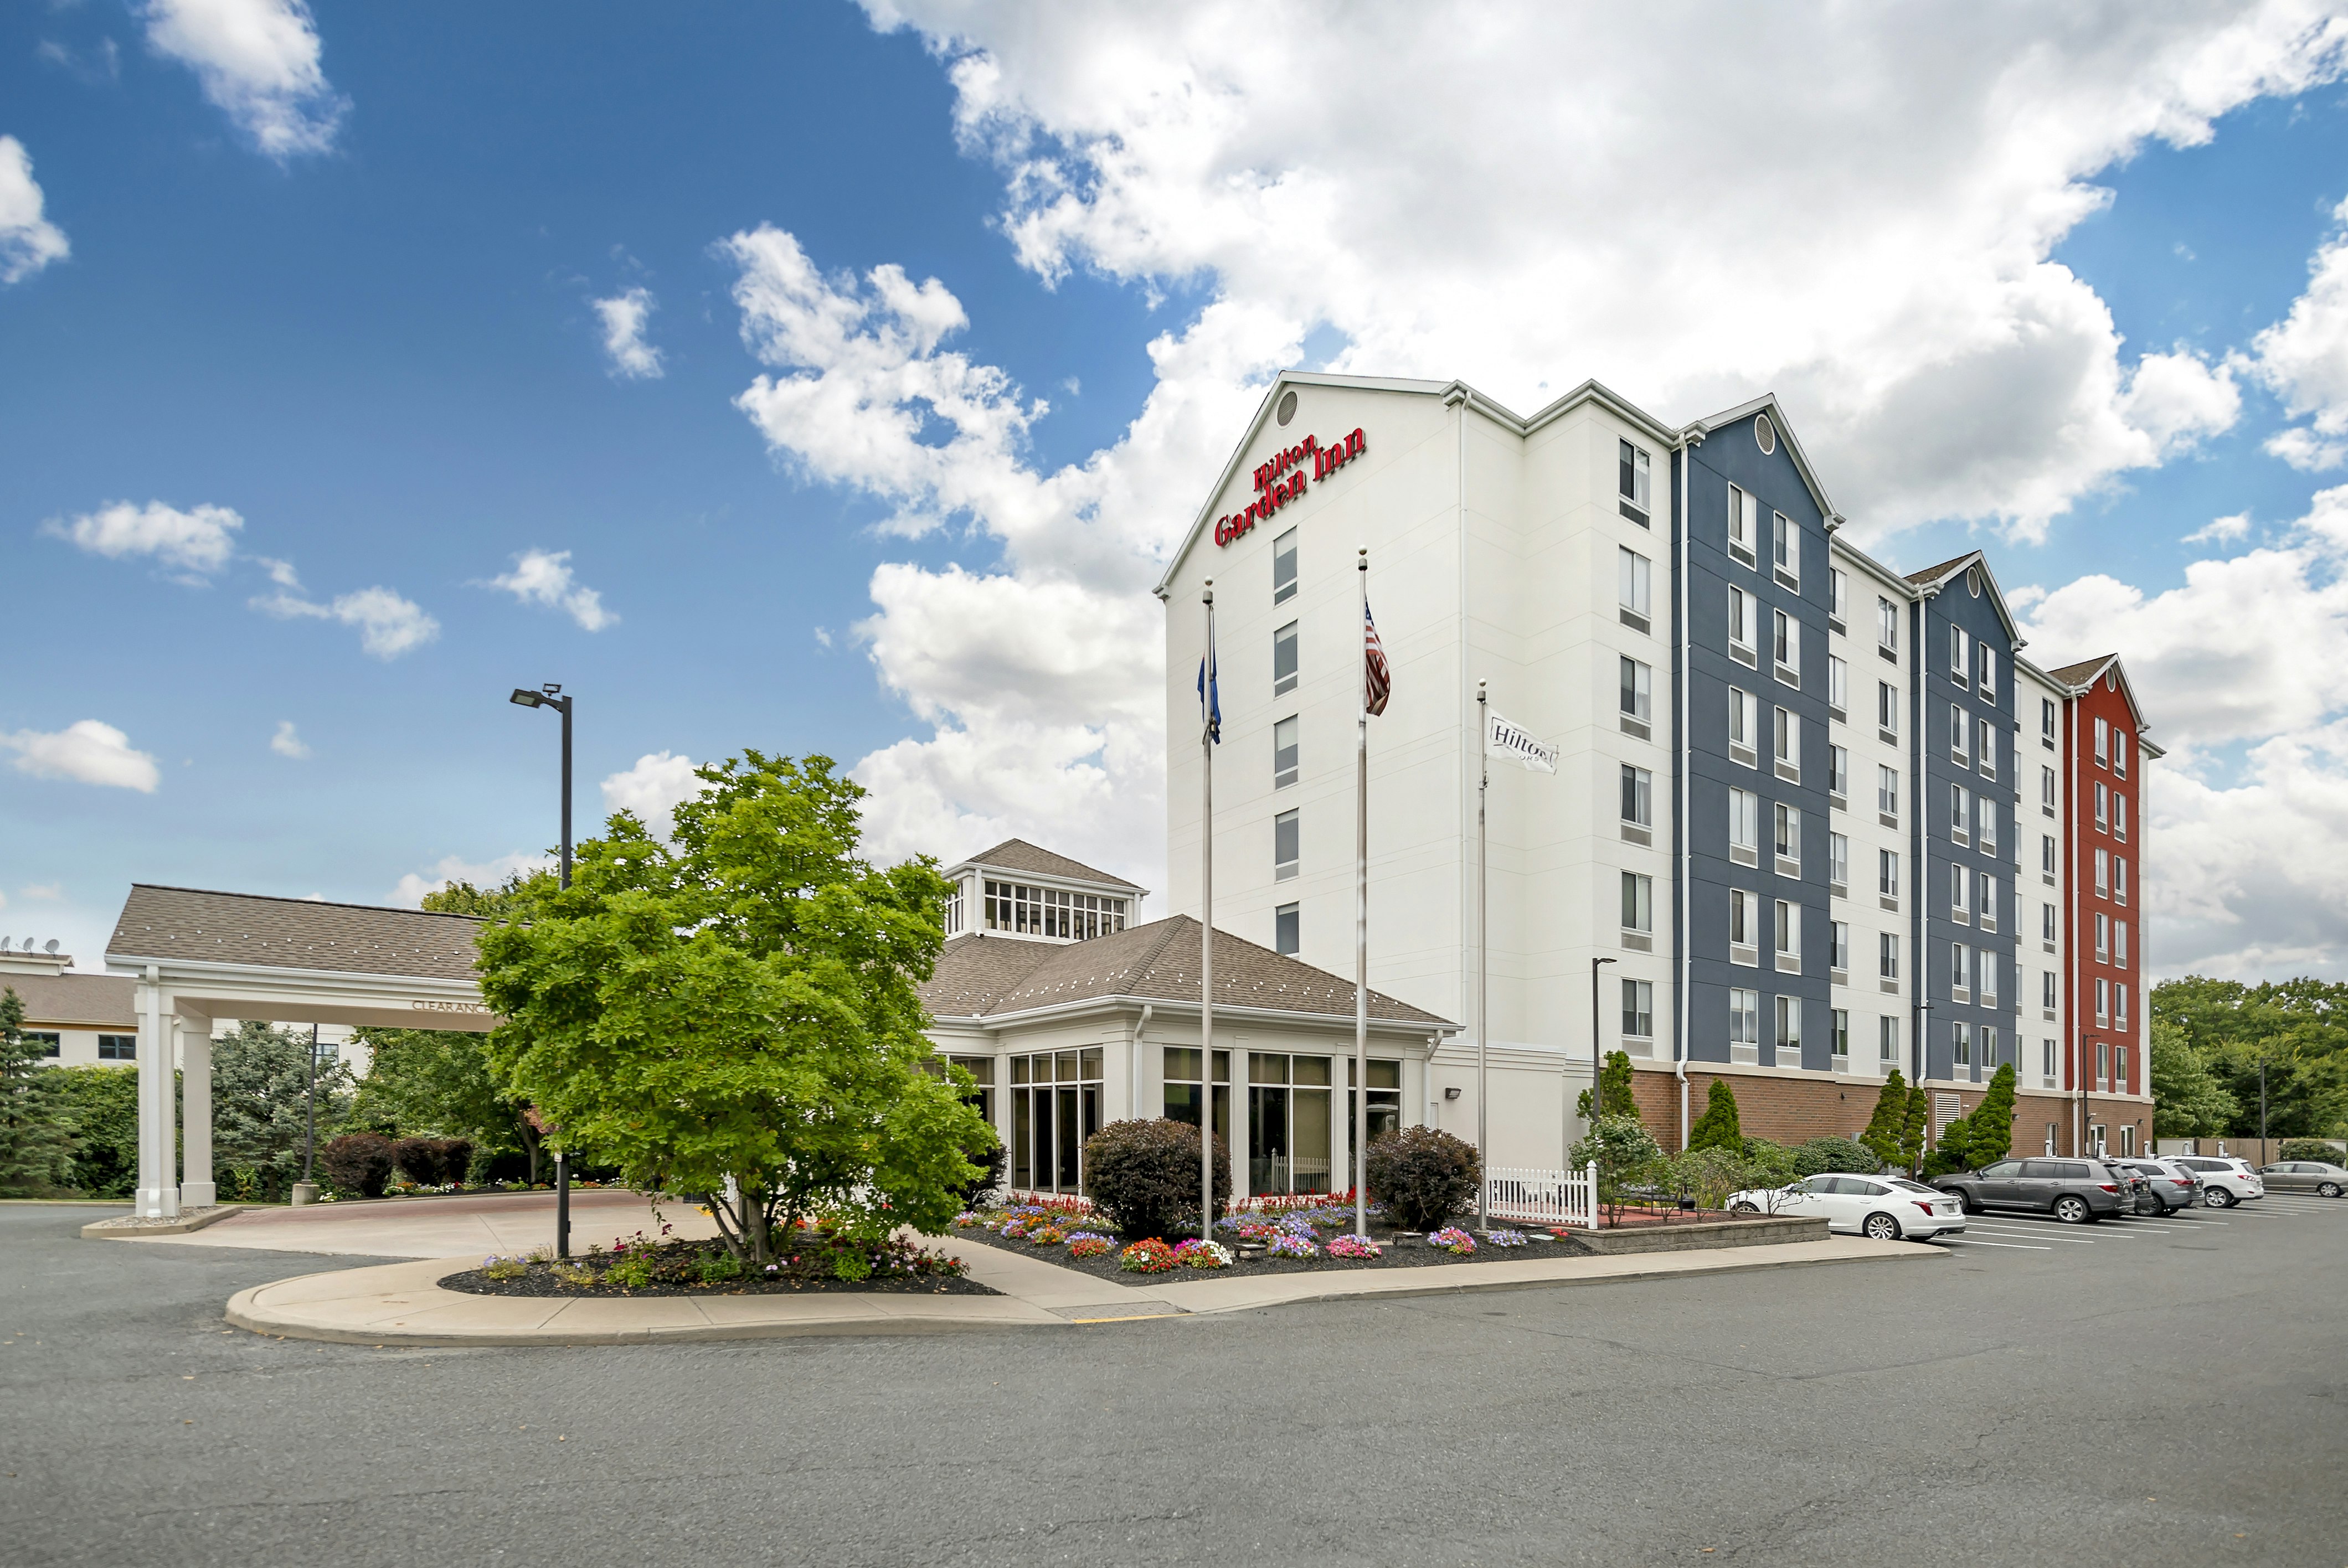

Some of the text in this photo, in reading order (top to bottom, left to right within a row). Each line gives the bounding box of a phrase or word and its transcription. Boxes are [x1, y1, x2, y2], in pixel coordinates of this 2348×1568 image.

[1253, 434, 1317, 492] Hilton
[1214, 427, 1366, 548] Garden Inn
[1495, 725, 1547, 760] Hilton
[412, 1000, 492, 1014] CLEARANCE
